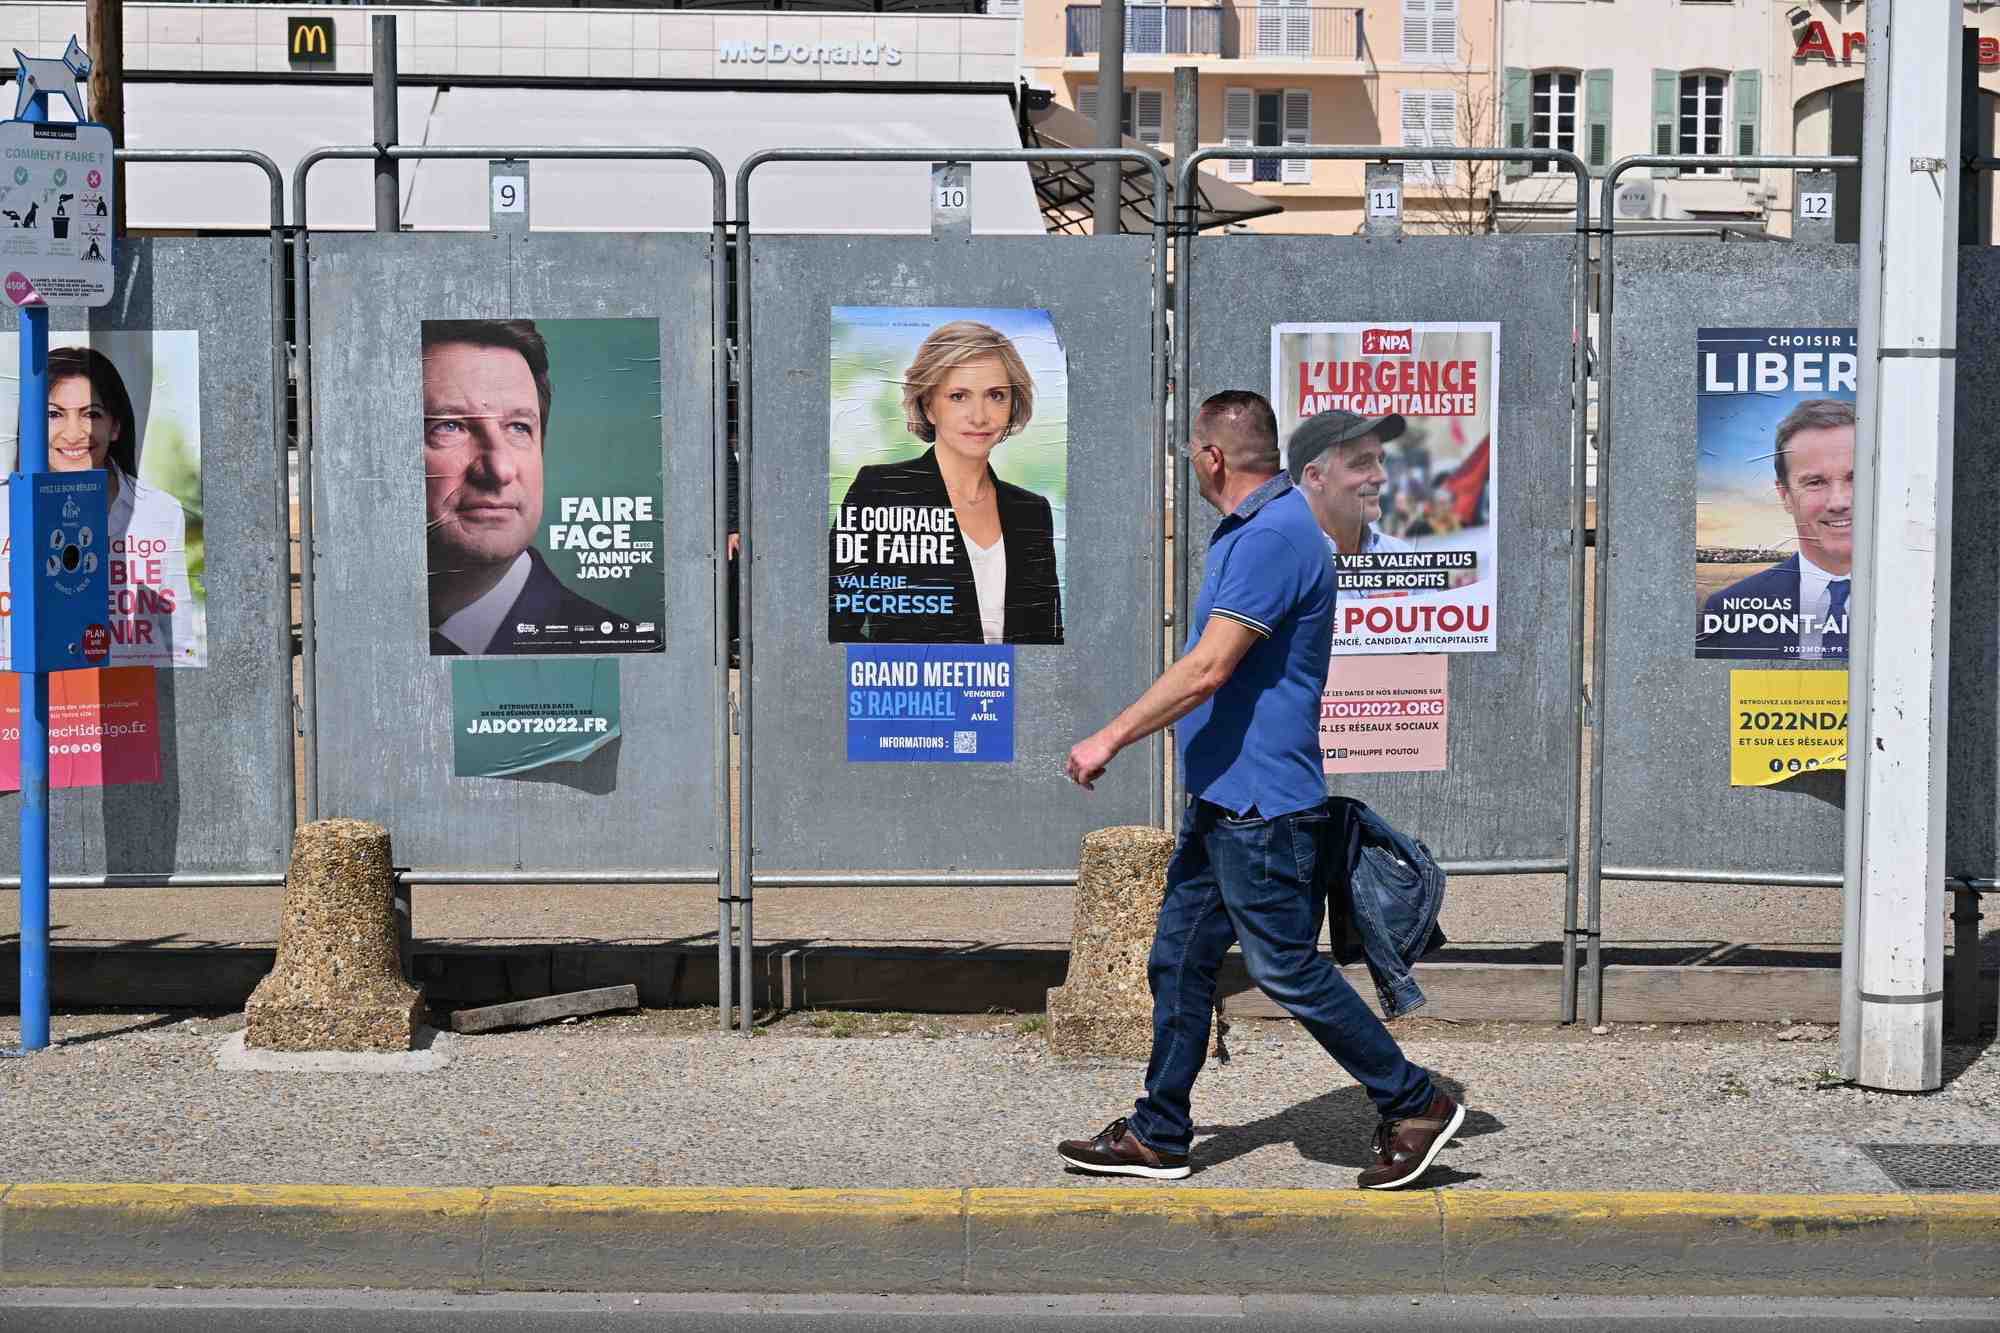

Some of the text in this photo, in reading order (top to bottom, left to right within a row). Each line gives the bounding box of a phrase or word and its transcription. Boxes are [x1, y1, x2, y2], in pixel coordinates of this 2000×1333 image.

[720, 40, 902, 66] McDonald's
[6, 148, 61, 161] COMMENT
[64, 151, 95, 162] FAIRE
[501, 185, 515, 207] 9
[941, 190, 964, 207] 10
[1375, 192, 1396, 209] 11
[1805, 197, 1827, 213] 12
[1379, 335, 1411, 350] NPA
[1768, 335, 1841, 347] CHOISIR
[1299, 360, 1476, 393] L'URGENCE
[1301, 393, 1474, 416] ANTICAPITALISTE
[561, 496, 652, 522] FAIRE
[836, 506, 955, 533] LE COURAGE
[549, 524, 631, 550] FACE
[107, 535, 166, 558] algo
[836, 533, 955, 565] DE FAIRE
[576, 551, 653, 565] YANNICK
[1341, 554, 1373, 568] VIES
[1377, 554, 1433, 568] VALENT
[1436, 553, 1472, 567] PLUS
[109, 559, 161, 585] BLE
[576, 565, 633, 579] JADOT
[838, 572, 908, 589] VALÉRIE
[1338, 573, 1446, 588] LEURS PROFITS
[836, 590, 954, 615] PÉCRESSE
[1723, 597, 1792, 610] NICOLAS
[1344, 604, 1489, 634] POUTOU
[1703, 613, 1848, 634] DUPONT-AI
[1365, 637, 1412, 645] CANDIDAT
[1414, 635, 1489, 644] ANTICAPITALISTE
[851, 660, 1010, 687] GRAND MEETING
[963, 690, 1005, 698] VENDREDI
[466, 717, 607, 734] JADOT2022.FR
[971, 713, 999, 721] AVRIL
[1330, 724, 1346, 733] LES
[1349, 721, 1392, 733] RÉSEAUX
[1395, 721, 1440, 732] SOCIAUX
[880, 736, 944, 749] INFORMATIONS
[1739, 737, 1844, 746] ET SUR LES RÉSEAUX
[1349, 747, 1419, 757] PHILIPPE POUTOU
